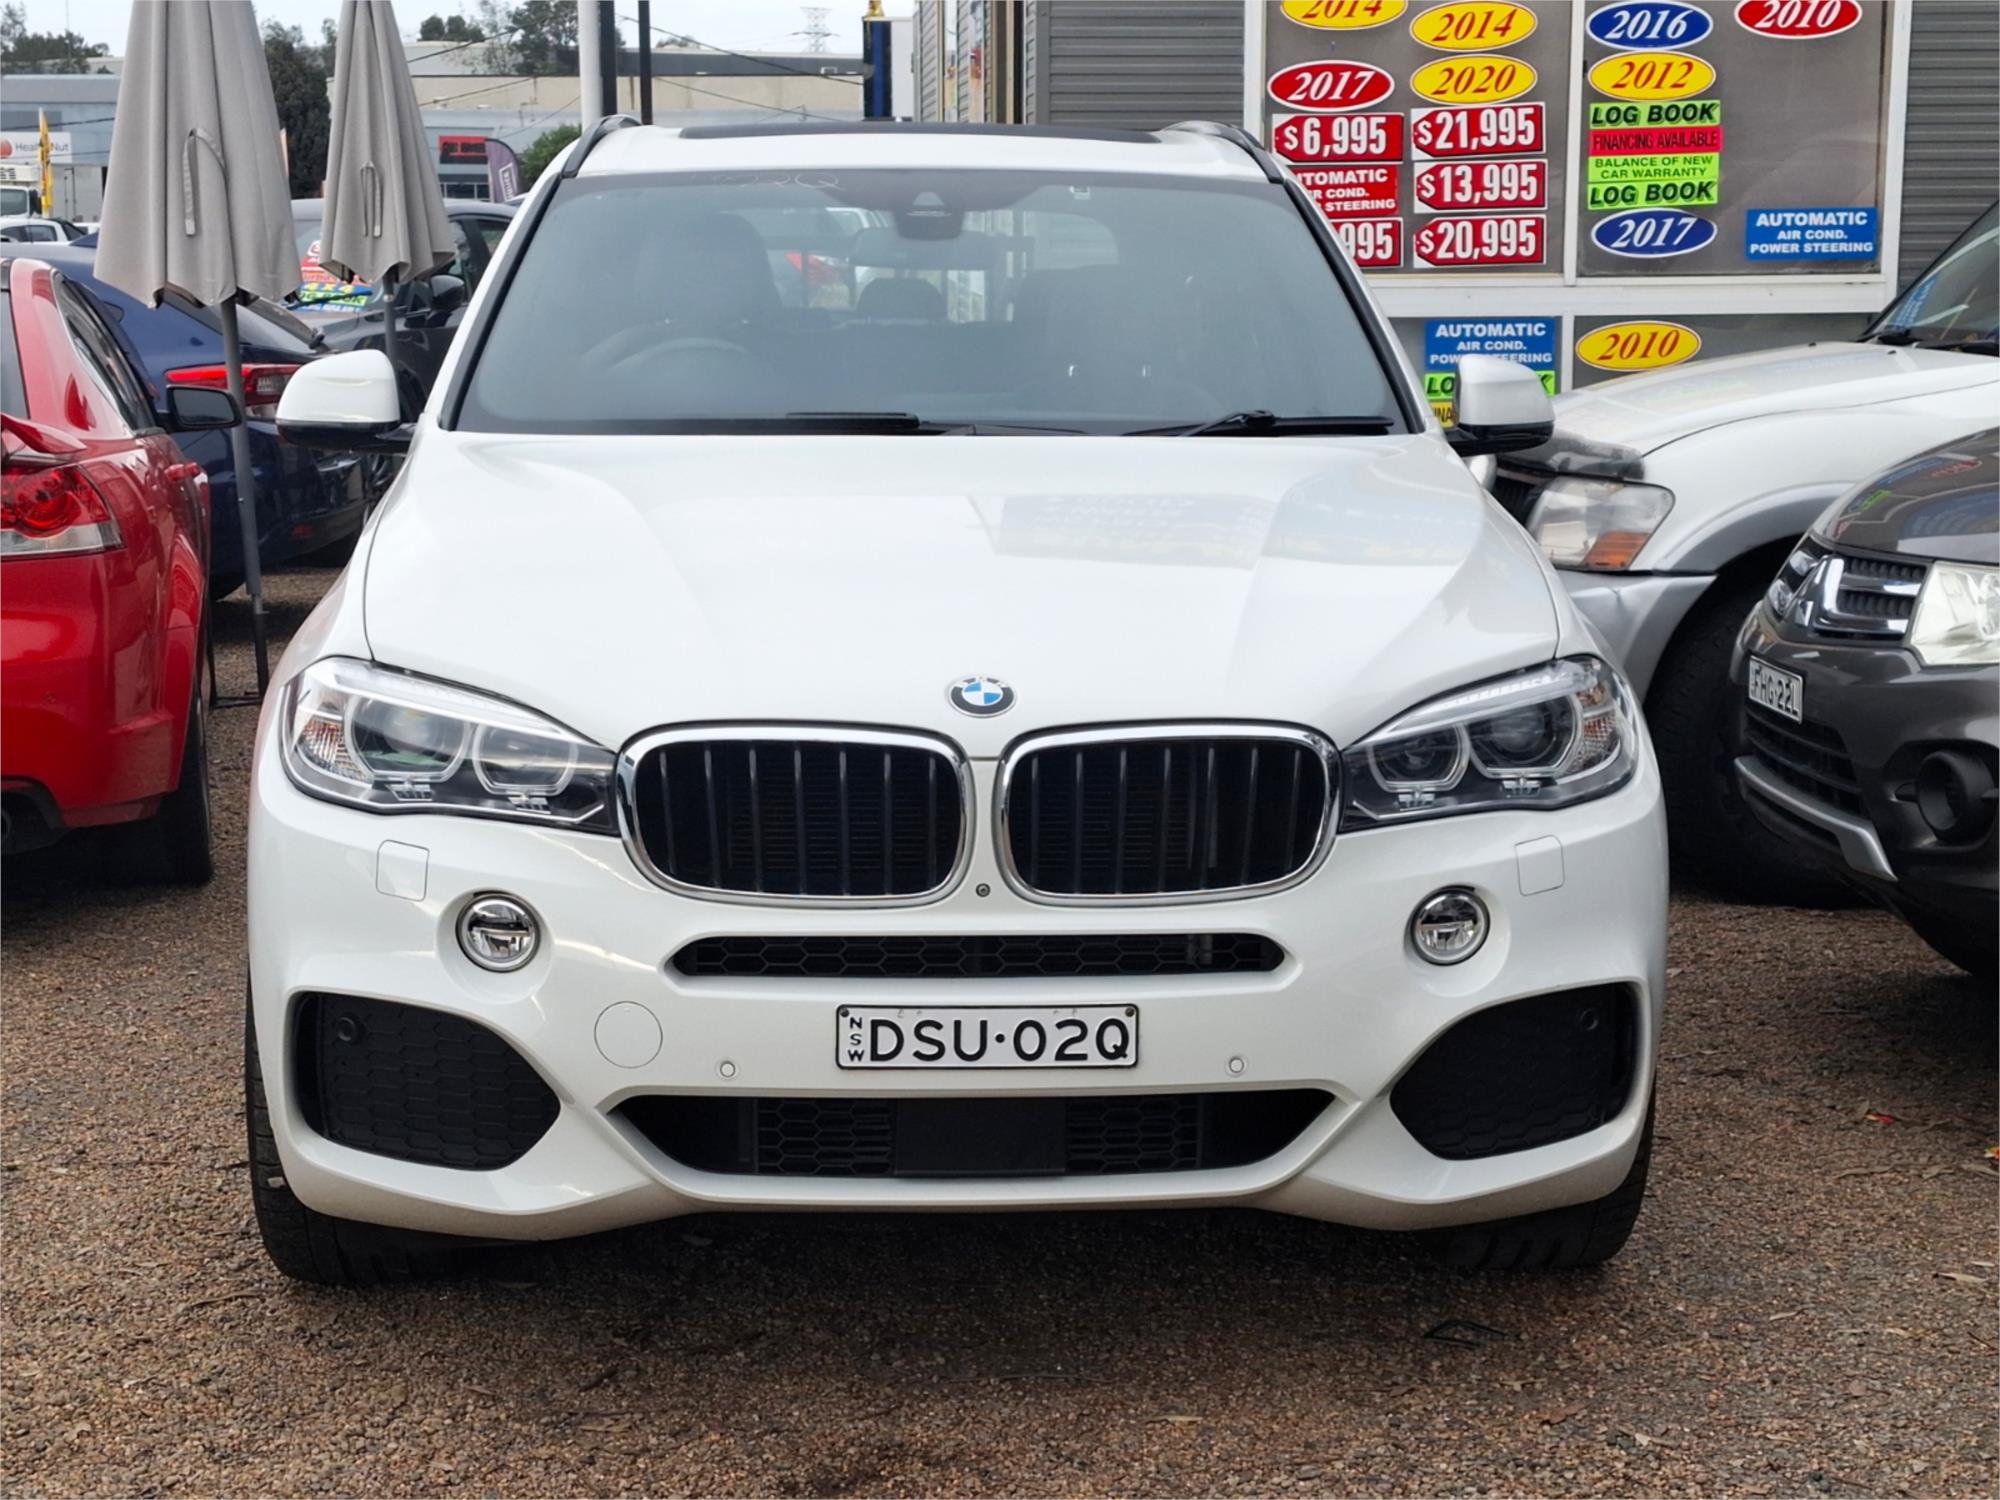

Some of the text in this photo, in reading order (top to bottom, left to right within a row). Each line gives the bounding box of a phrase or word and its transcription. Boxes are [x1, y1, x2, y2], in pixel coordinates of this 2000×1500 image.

[1302, 0, 1383, 18] 2014
[1754, 0, 1841, 28] 2010
[1432, 8, 1518, 42] 2014
[1603, 9, 1694, 39] 2016
[1432, 64, 1516, 95] 2020
[1612, 61, 1694, 89] 2012
[1287, 70, 1375, 101] 2017
[1592, 103, 1719, 125] LOG BOOK
[1283, 116, 1387, 157] $6,995
[1417, 107, 1535, 150] $21,995
[1594, 131, 1717, 150] FINANCING AVAILABLE
[1595, 156, 1713, 168] BALANCE OF NEW
[1297, 169, 1388, 185] TOMATIC
[1601, 167, 1707, 179] CAR WARRANTY
[1326, 187, 1370, 198] COND.
[1420, 163, 1538, 204] $13,995
[1590, 181, 1717, 206] LOG BOOK
[1325, 199, 1395, 212] STEERING
[1756, 212, 1868, 227] AUTOMATIC
[1420, 220, 1536, 260] $20,995
[1611, 217, 1698, 247] 2017
[1777, 229, 1848, 240] AIR COND.
[1750, 242, 1873, 254] POWER STEERING
[1435, 323, 1546, 337] AUTOMATIC
[1457, 340, 1527, 350] AIR COND.
[1597, 329, 1680, 360] 2010
[1430, 354, 1461, 364] POW
[1427, 376, 1455, 394] LO
